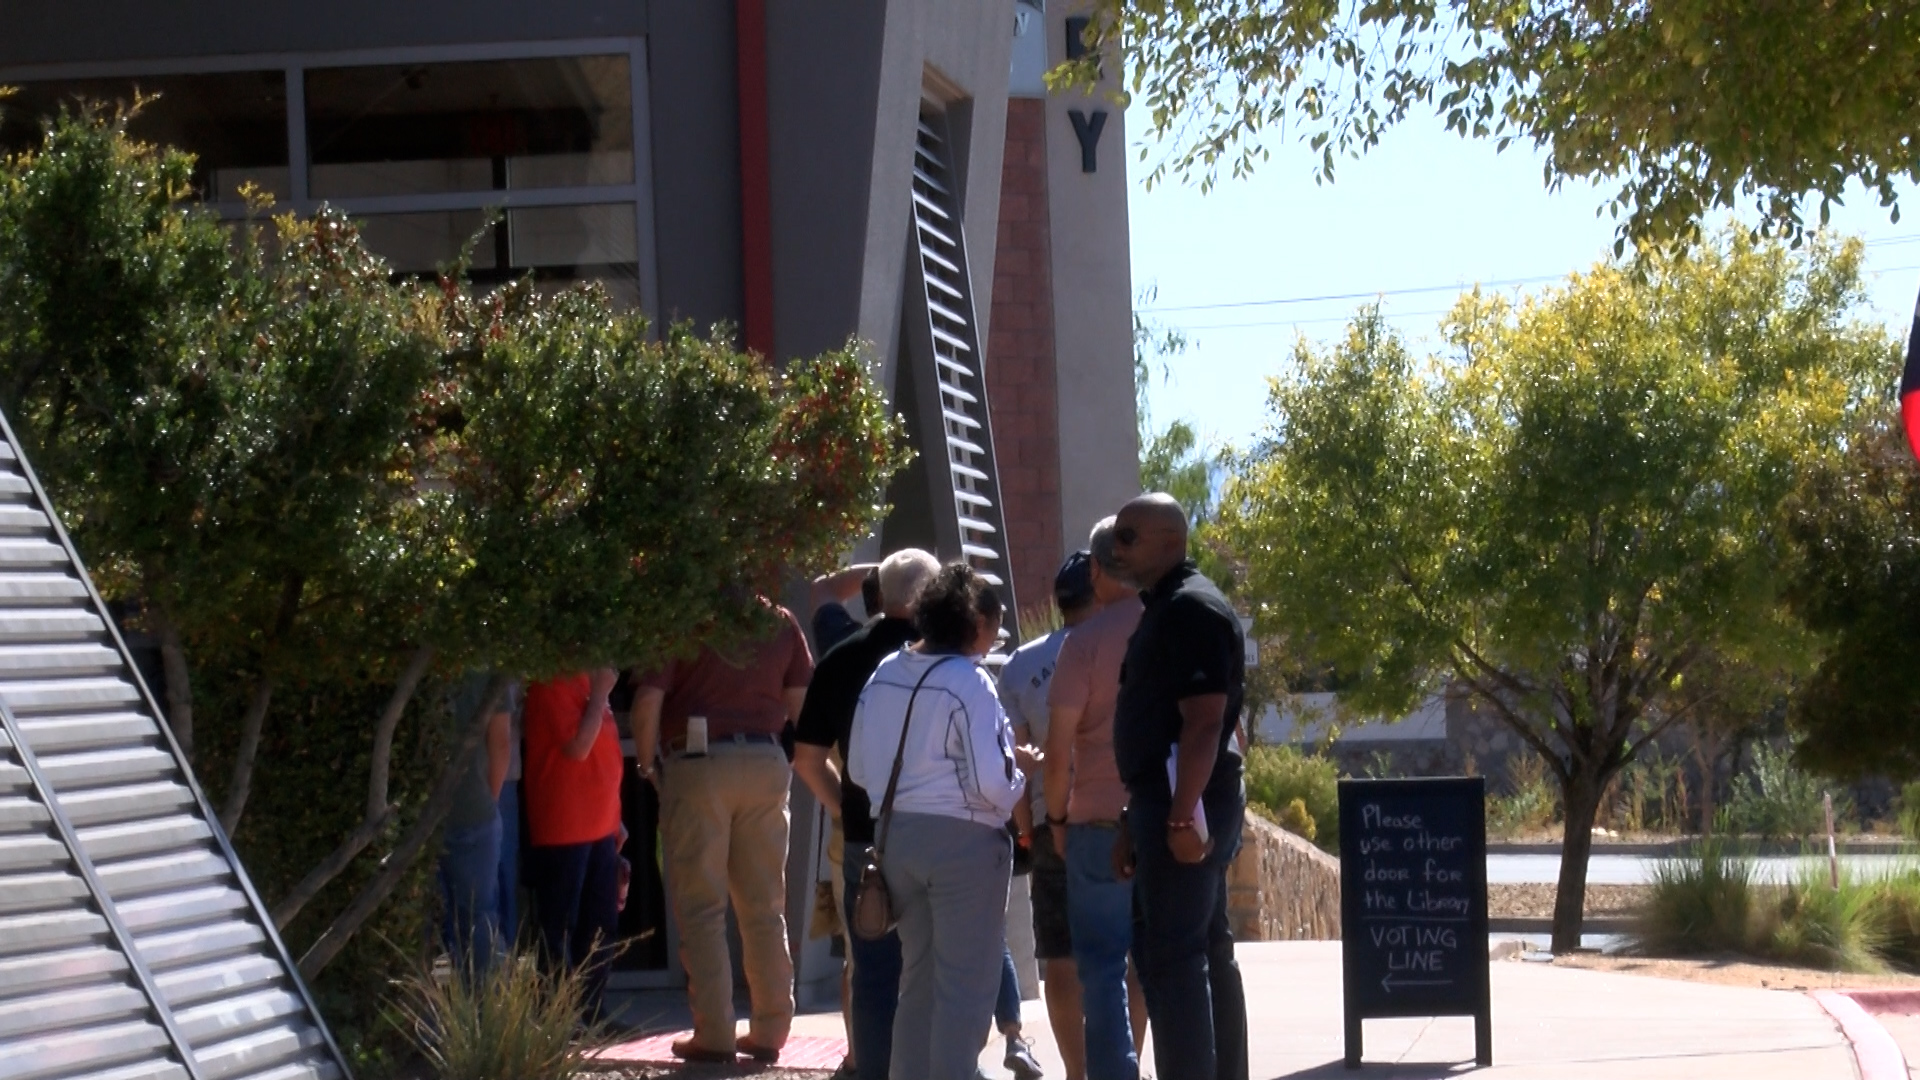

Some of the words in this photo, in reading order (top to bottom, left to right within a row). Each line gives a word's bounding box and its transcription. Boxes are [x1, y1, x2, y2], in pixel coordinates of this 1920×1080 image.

[1362, 804, 1422, 829] Please
[1360, 837, 1391, 855] use
[1403, 831, 1462, 850] other
[1365, 890, 1396, 909] the
[1370, 927, 1457, 949] VOTING
[1388, 951, 1444, 971] LINE
